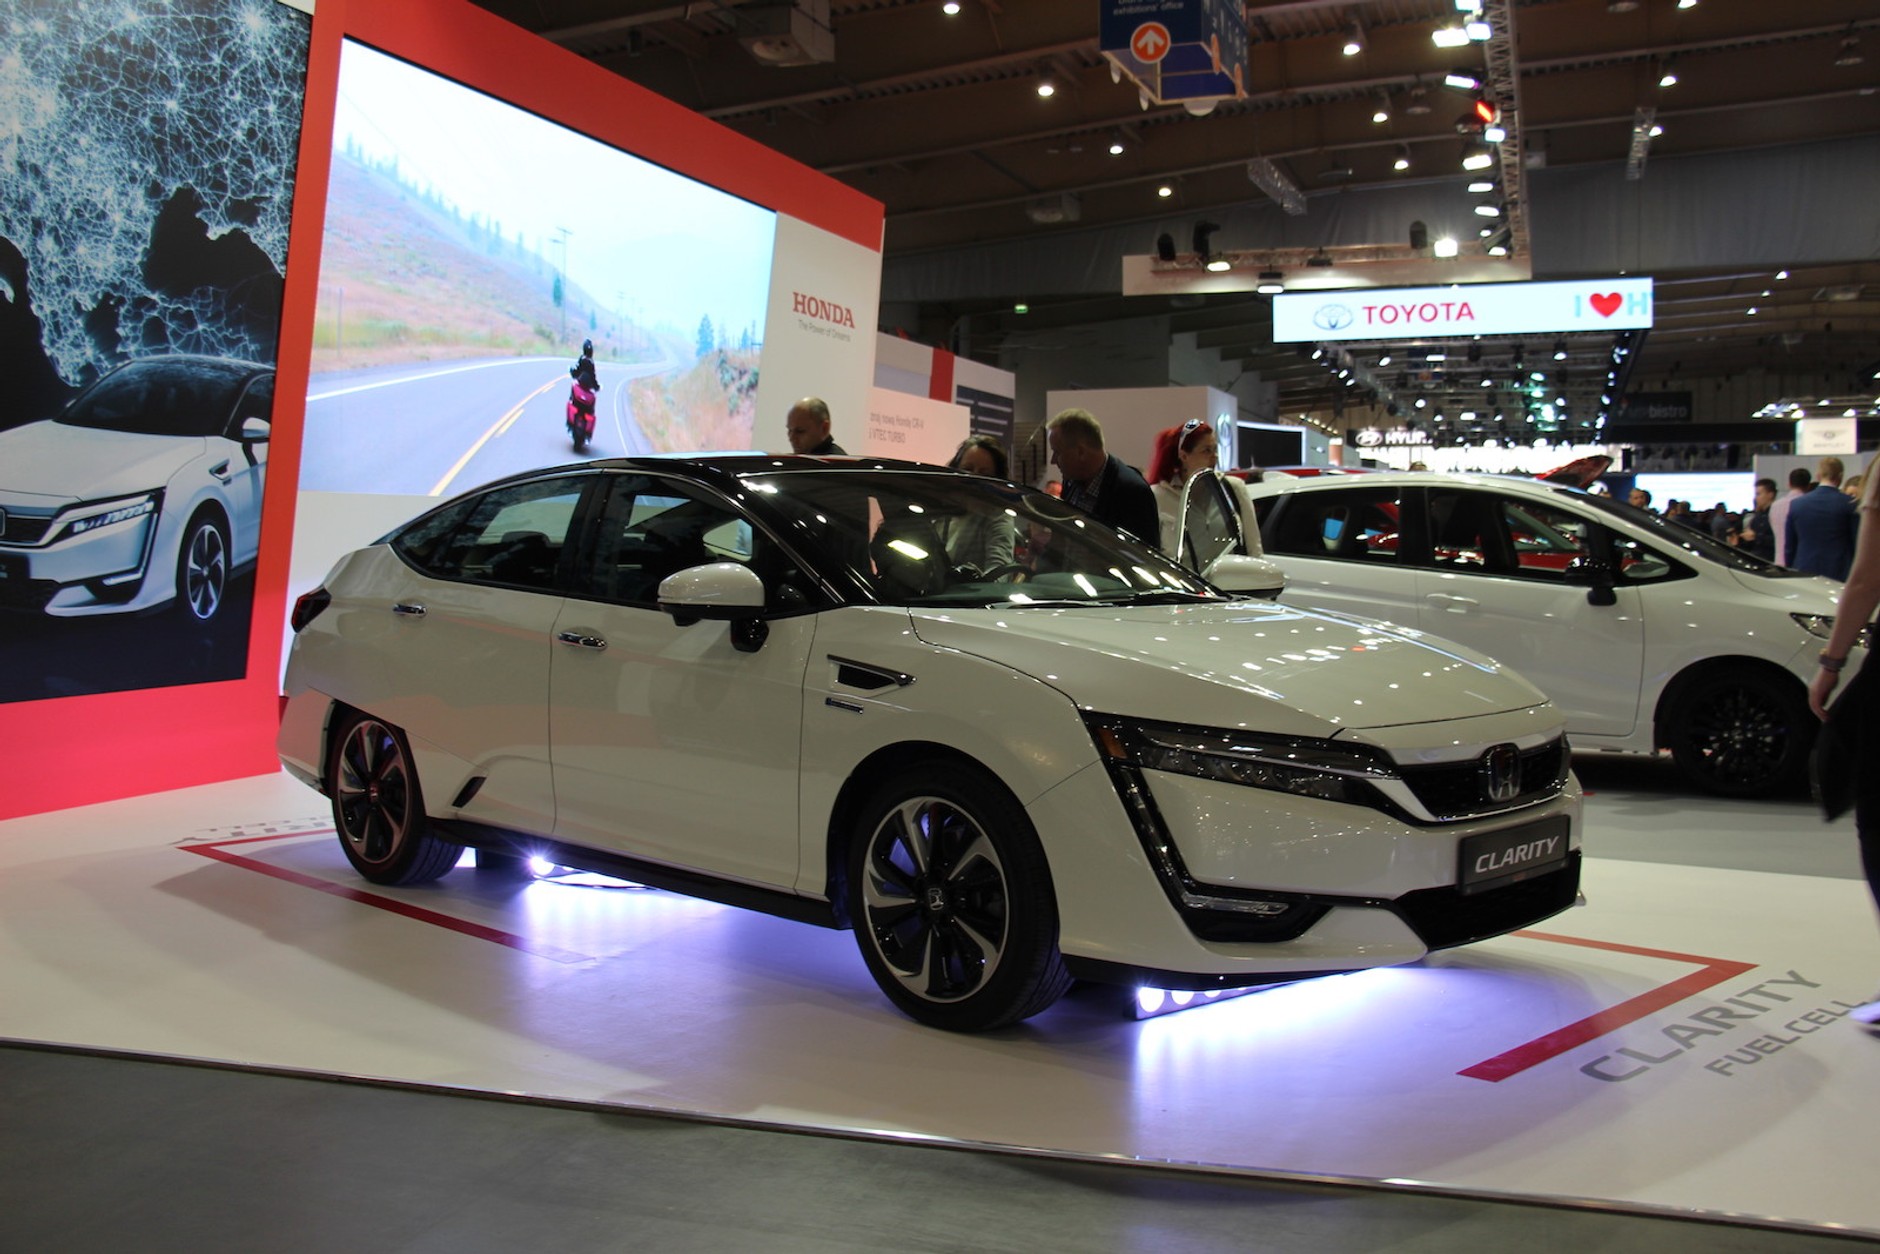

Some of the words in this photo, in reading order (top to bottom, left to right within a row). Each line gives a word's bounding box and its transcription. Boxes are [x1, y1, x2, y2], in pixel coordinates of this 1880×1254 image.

[792, 291, 855, 329] HONDA
[1362, 302, 1475, 325] TOYOTA
[1475, 836, 1559, 873] CLARITY
[1580, 970, 1821, 1082] CLARITY
